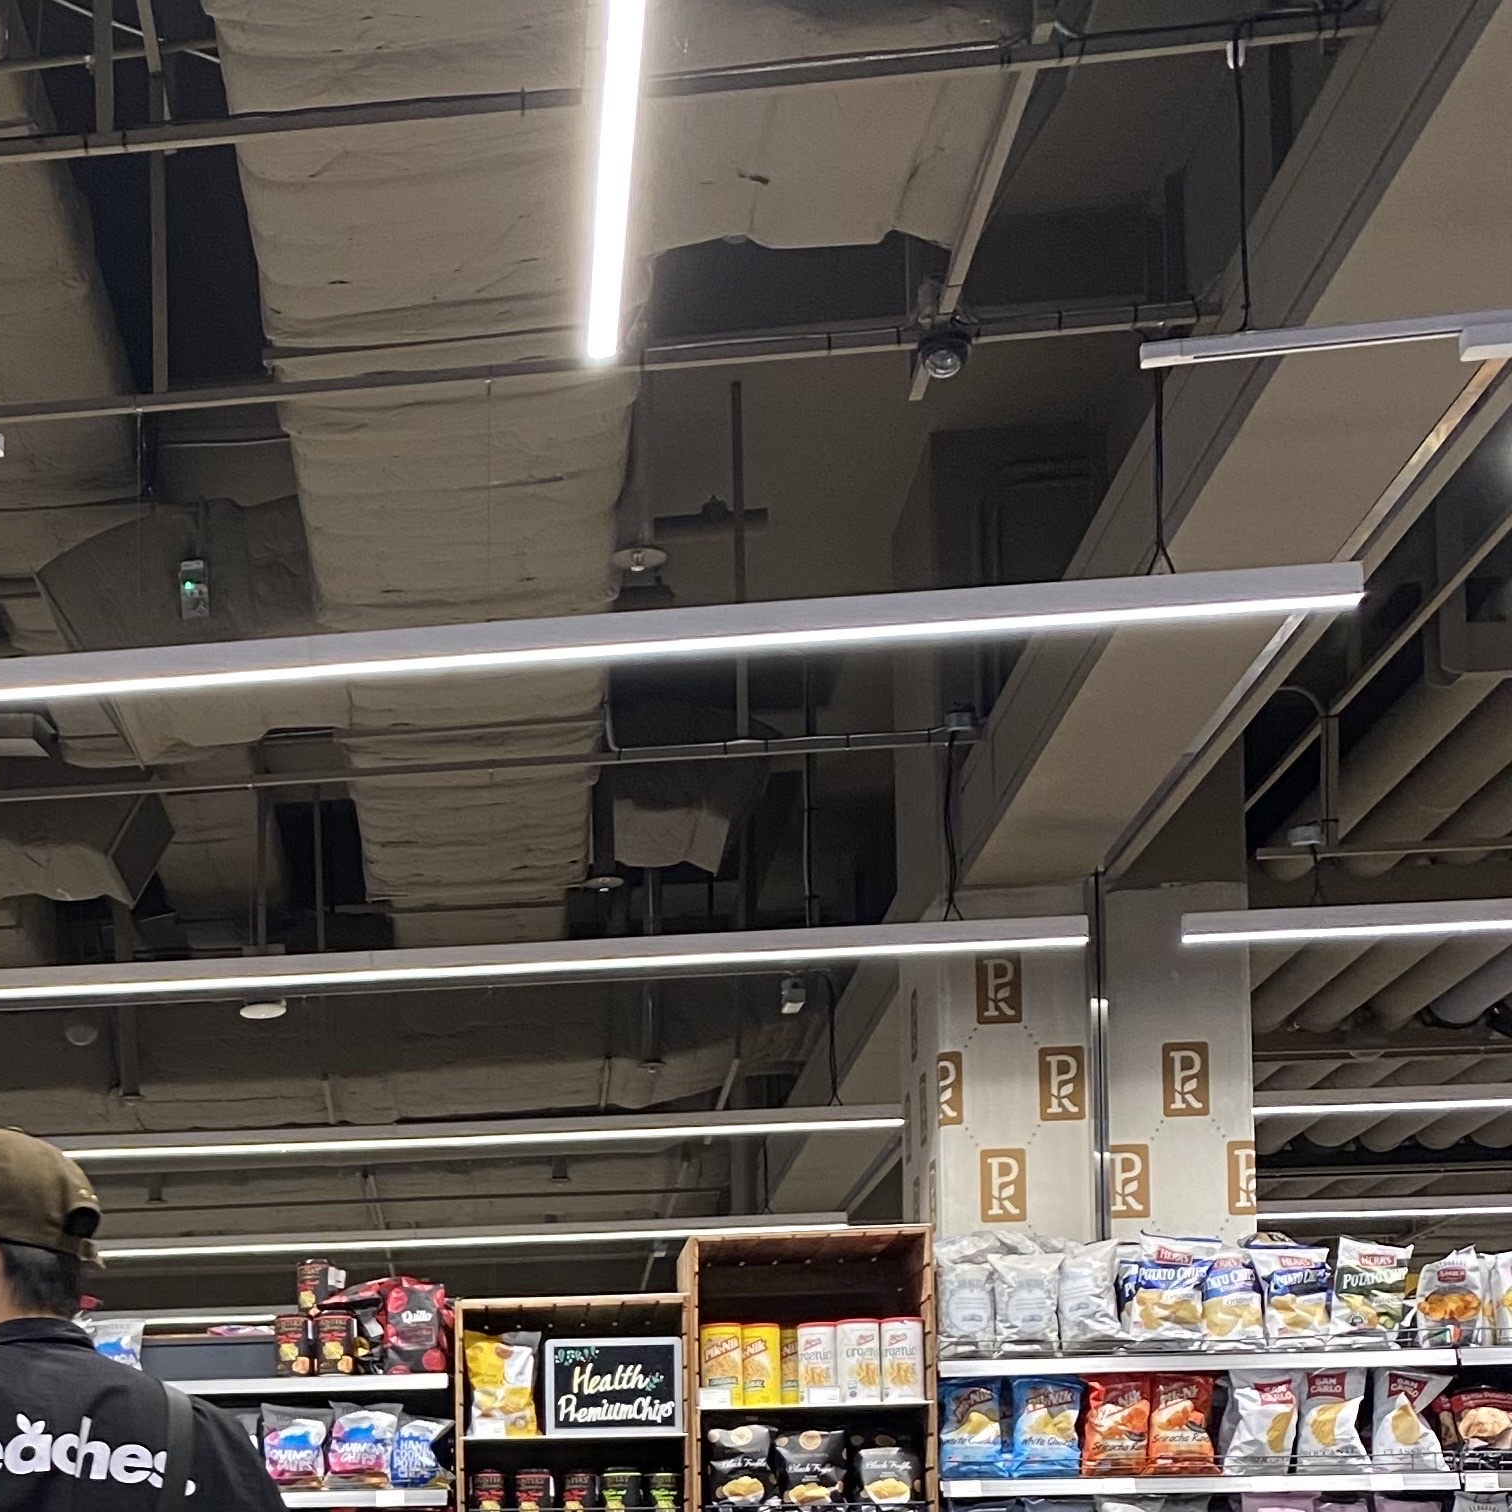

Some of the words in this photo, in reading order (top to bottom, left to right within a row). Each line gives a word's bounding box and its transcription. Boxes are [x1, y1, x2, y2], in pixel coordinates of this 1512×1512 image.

[401, 1310, 433, 1324] Quillo
[573, 1363, 651, 1395] Health
[1315, 1377, 1337, 1387] SAN
[1396, 1378, 1419, 1389] SAN
[1309, 1383, 1343, 1394] CARLO
[1389, 1383, 1419, 1399] CARLO
